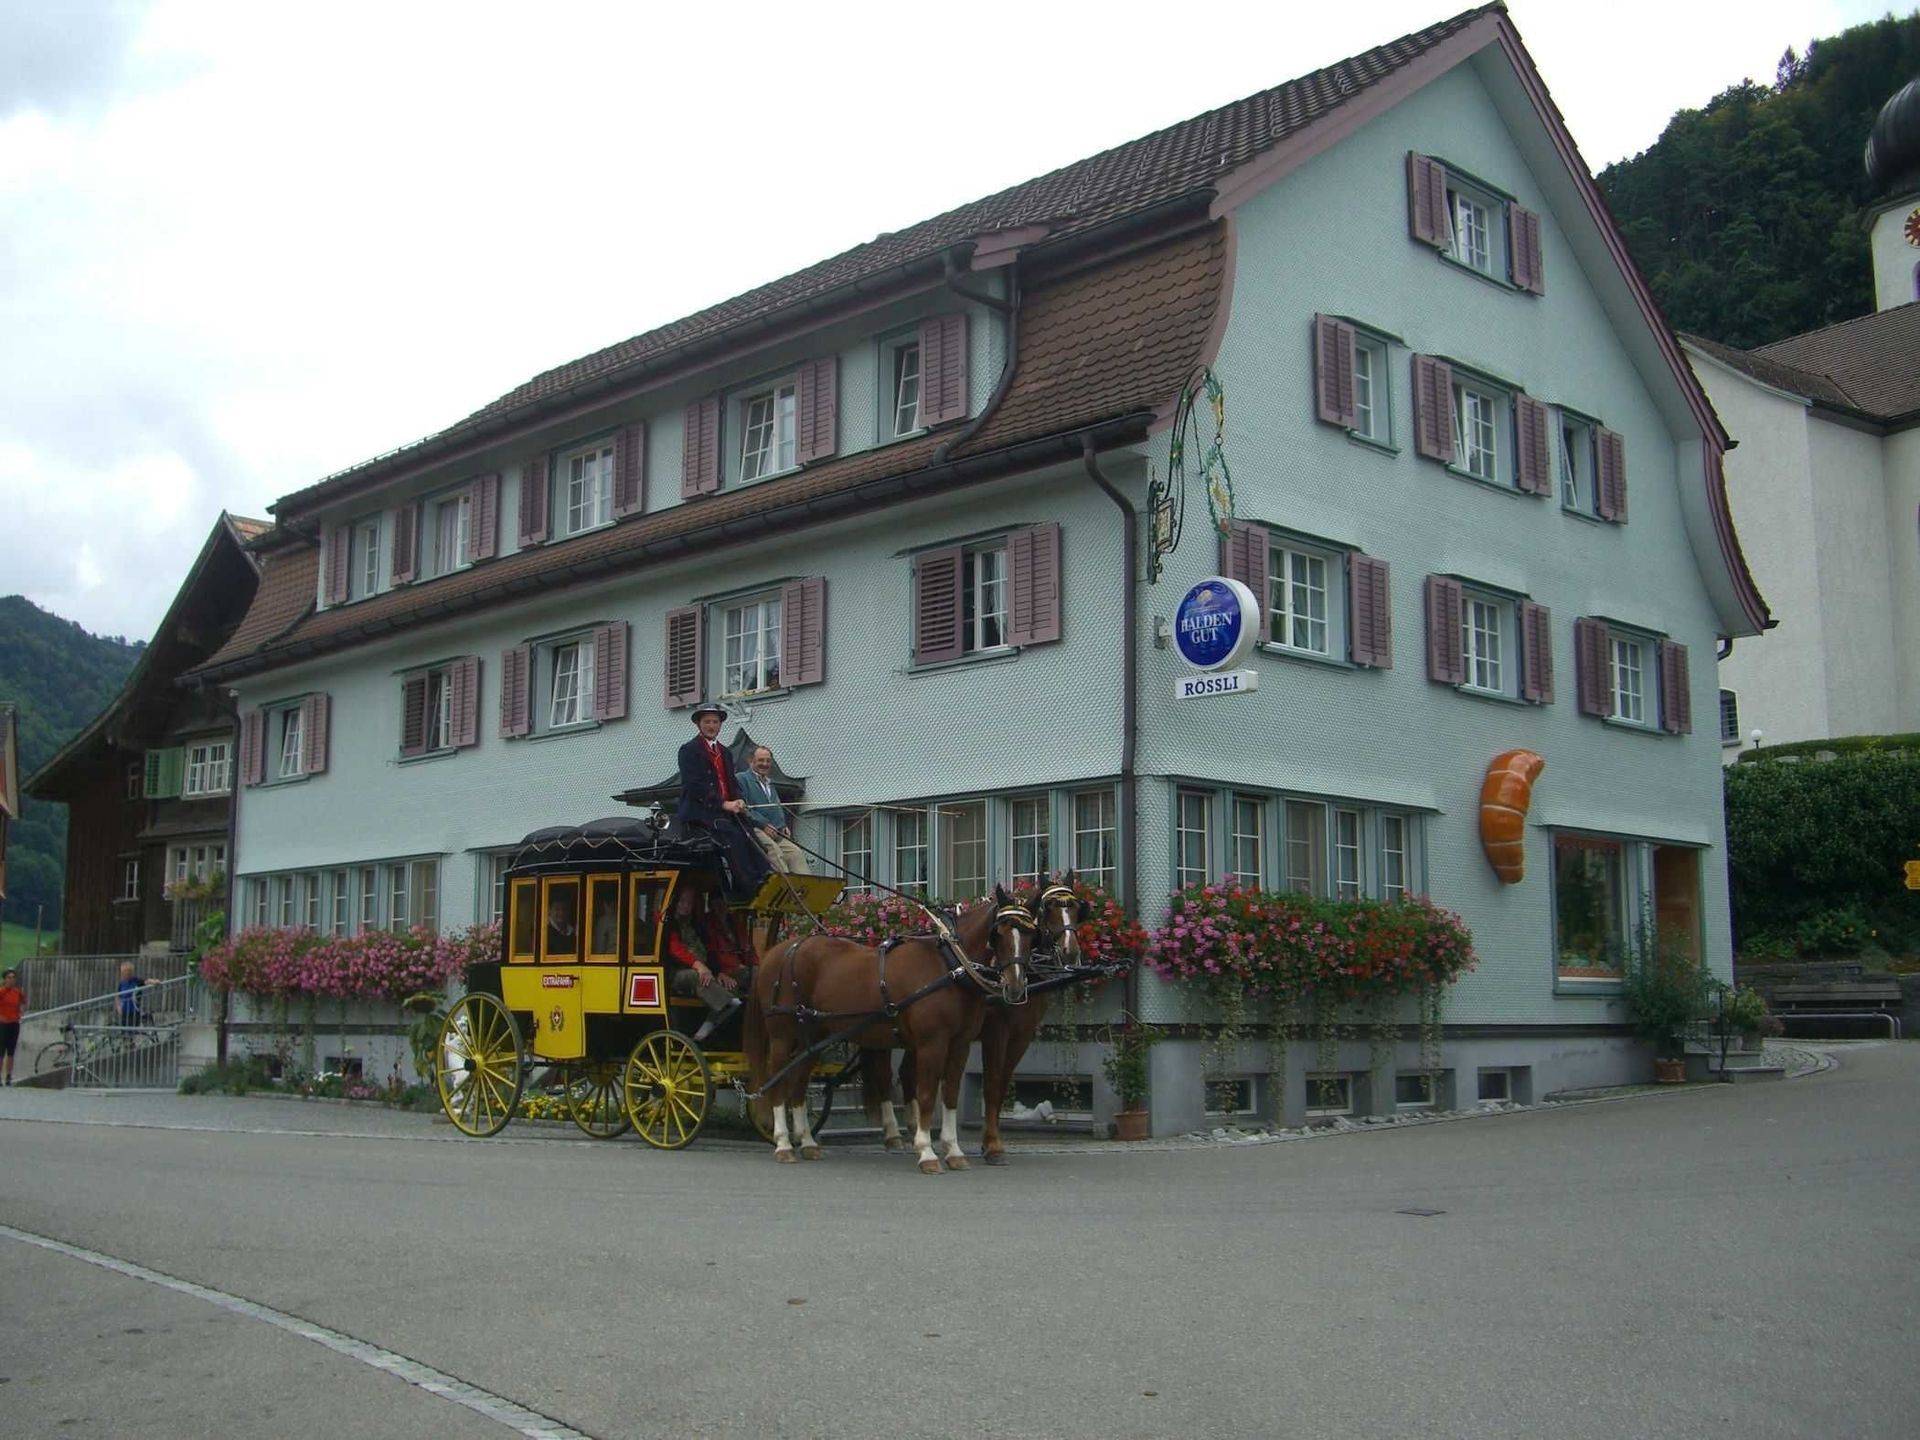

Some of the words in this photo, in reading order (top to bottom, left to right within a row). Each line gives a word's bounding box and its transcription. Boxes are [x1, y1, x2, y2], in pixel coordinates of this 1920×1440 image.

[1181, 612, 1233, 633] HALDEN
[1191, 627, 1219, 644] GUT
[1184, 676, 1239, 696] RÖSSLI
